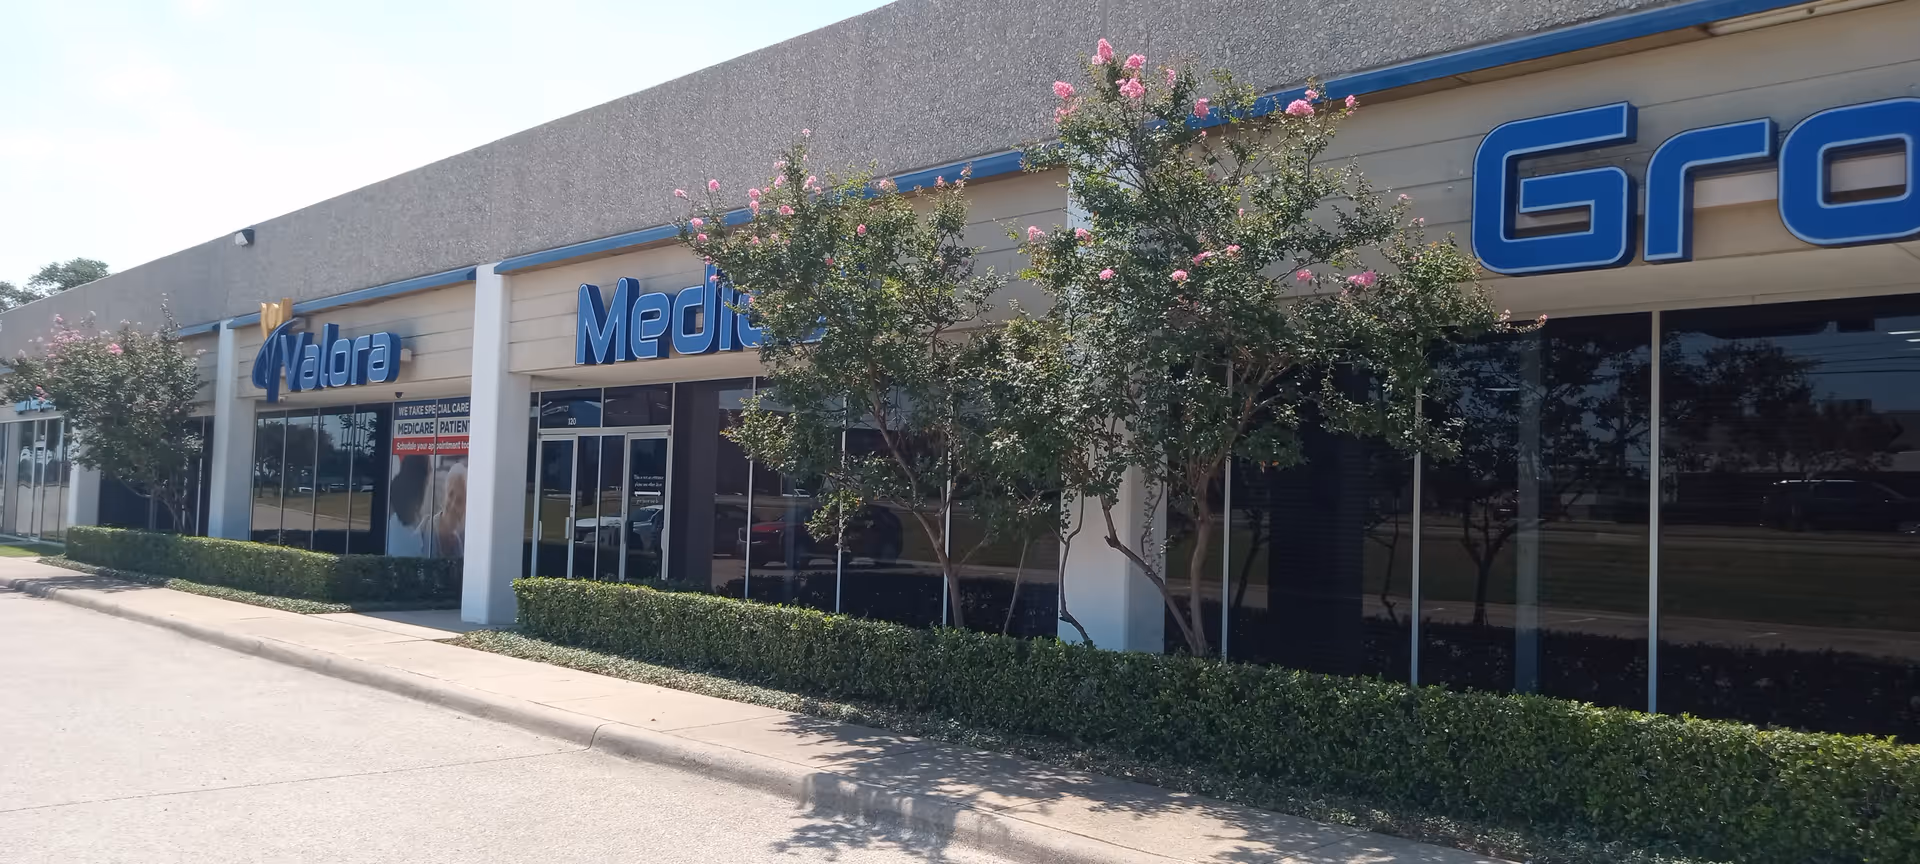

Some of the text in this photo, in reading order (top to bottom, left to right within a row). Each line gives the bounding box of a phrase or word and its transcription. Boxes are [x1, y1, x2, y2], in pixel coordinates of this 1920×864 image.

[280, 323, 400, 392] Valora
[398, 406, 408, 416] WE
[409, 405, 424, 415] TAKE
[452, 402, 469, 413] CARE
[397, 421, 434, 435] MEDICARE
[568, 417, 577, 426] 120
[396, 442, 416, 451] Schedule
